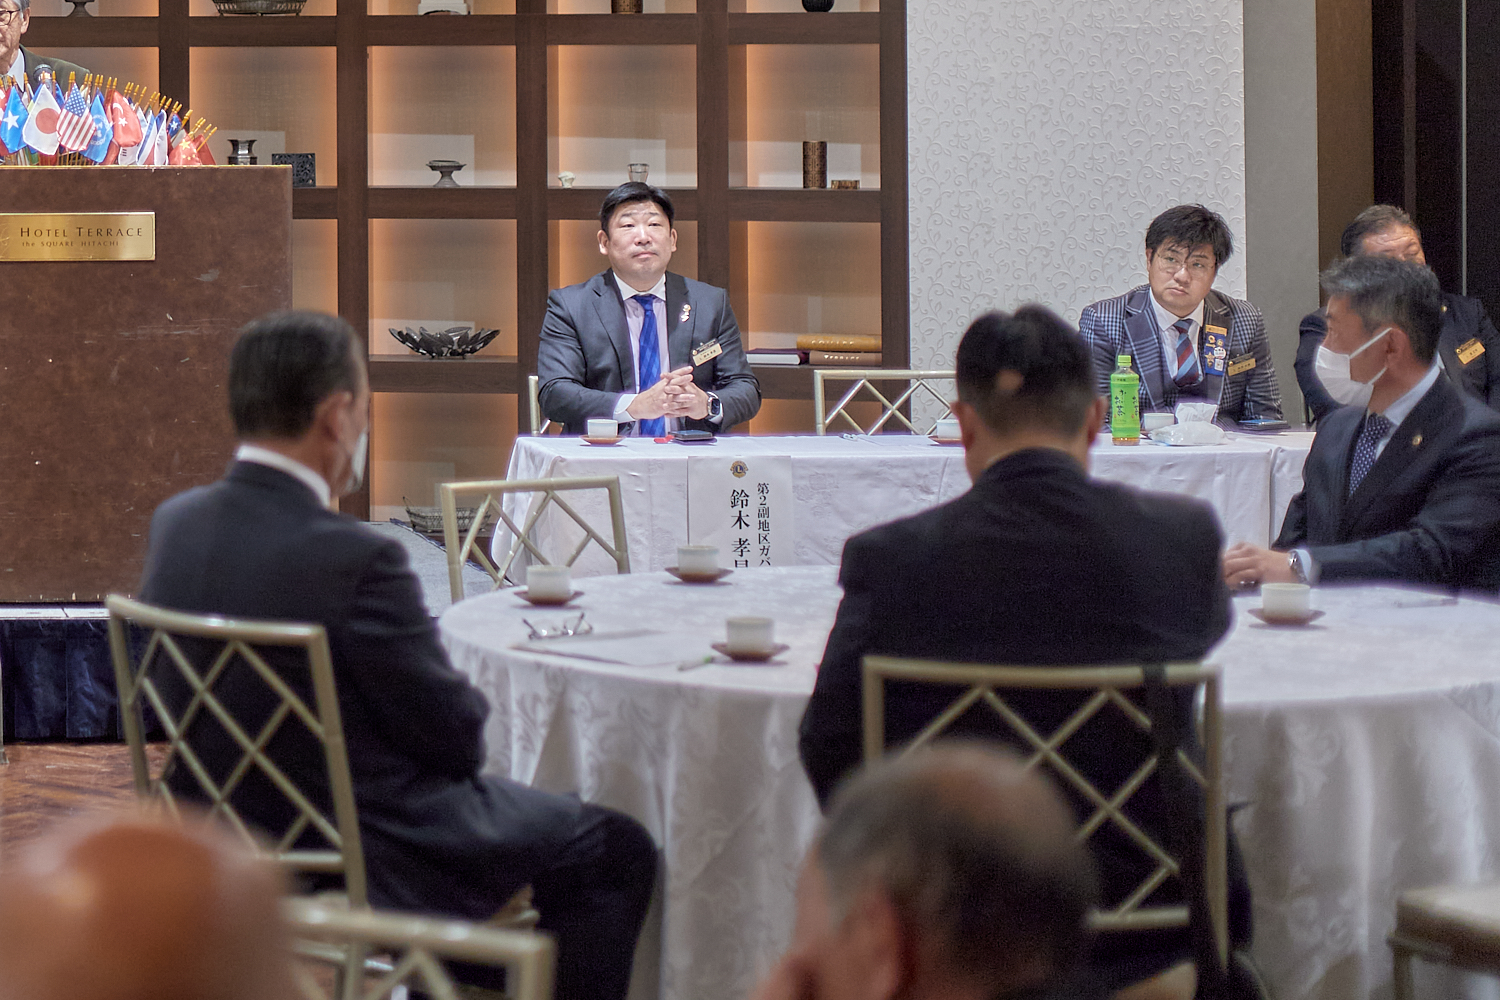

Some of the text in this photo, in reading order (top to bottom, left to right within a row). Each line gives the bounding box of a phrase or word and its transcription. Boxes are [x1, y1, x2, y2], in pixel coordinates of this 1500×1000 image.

[20, 226, 143, 238] HOTEL TERRACE
[40, 240, 74, 248] SQUARE
